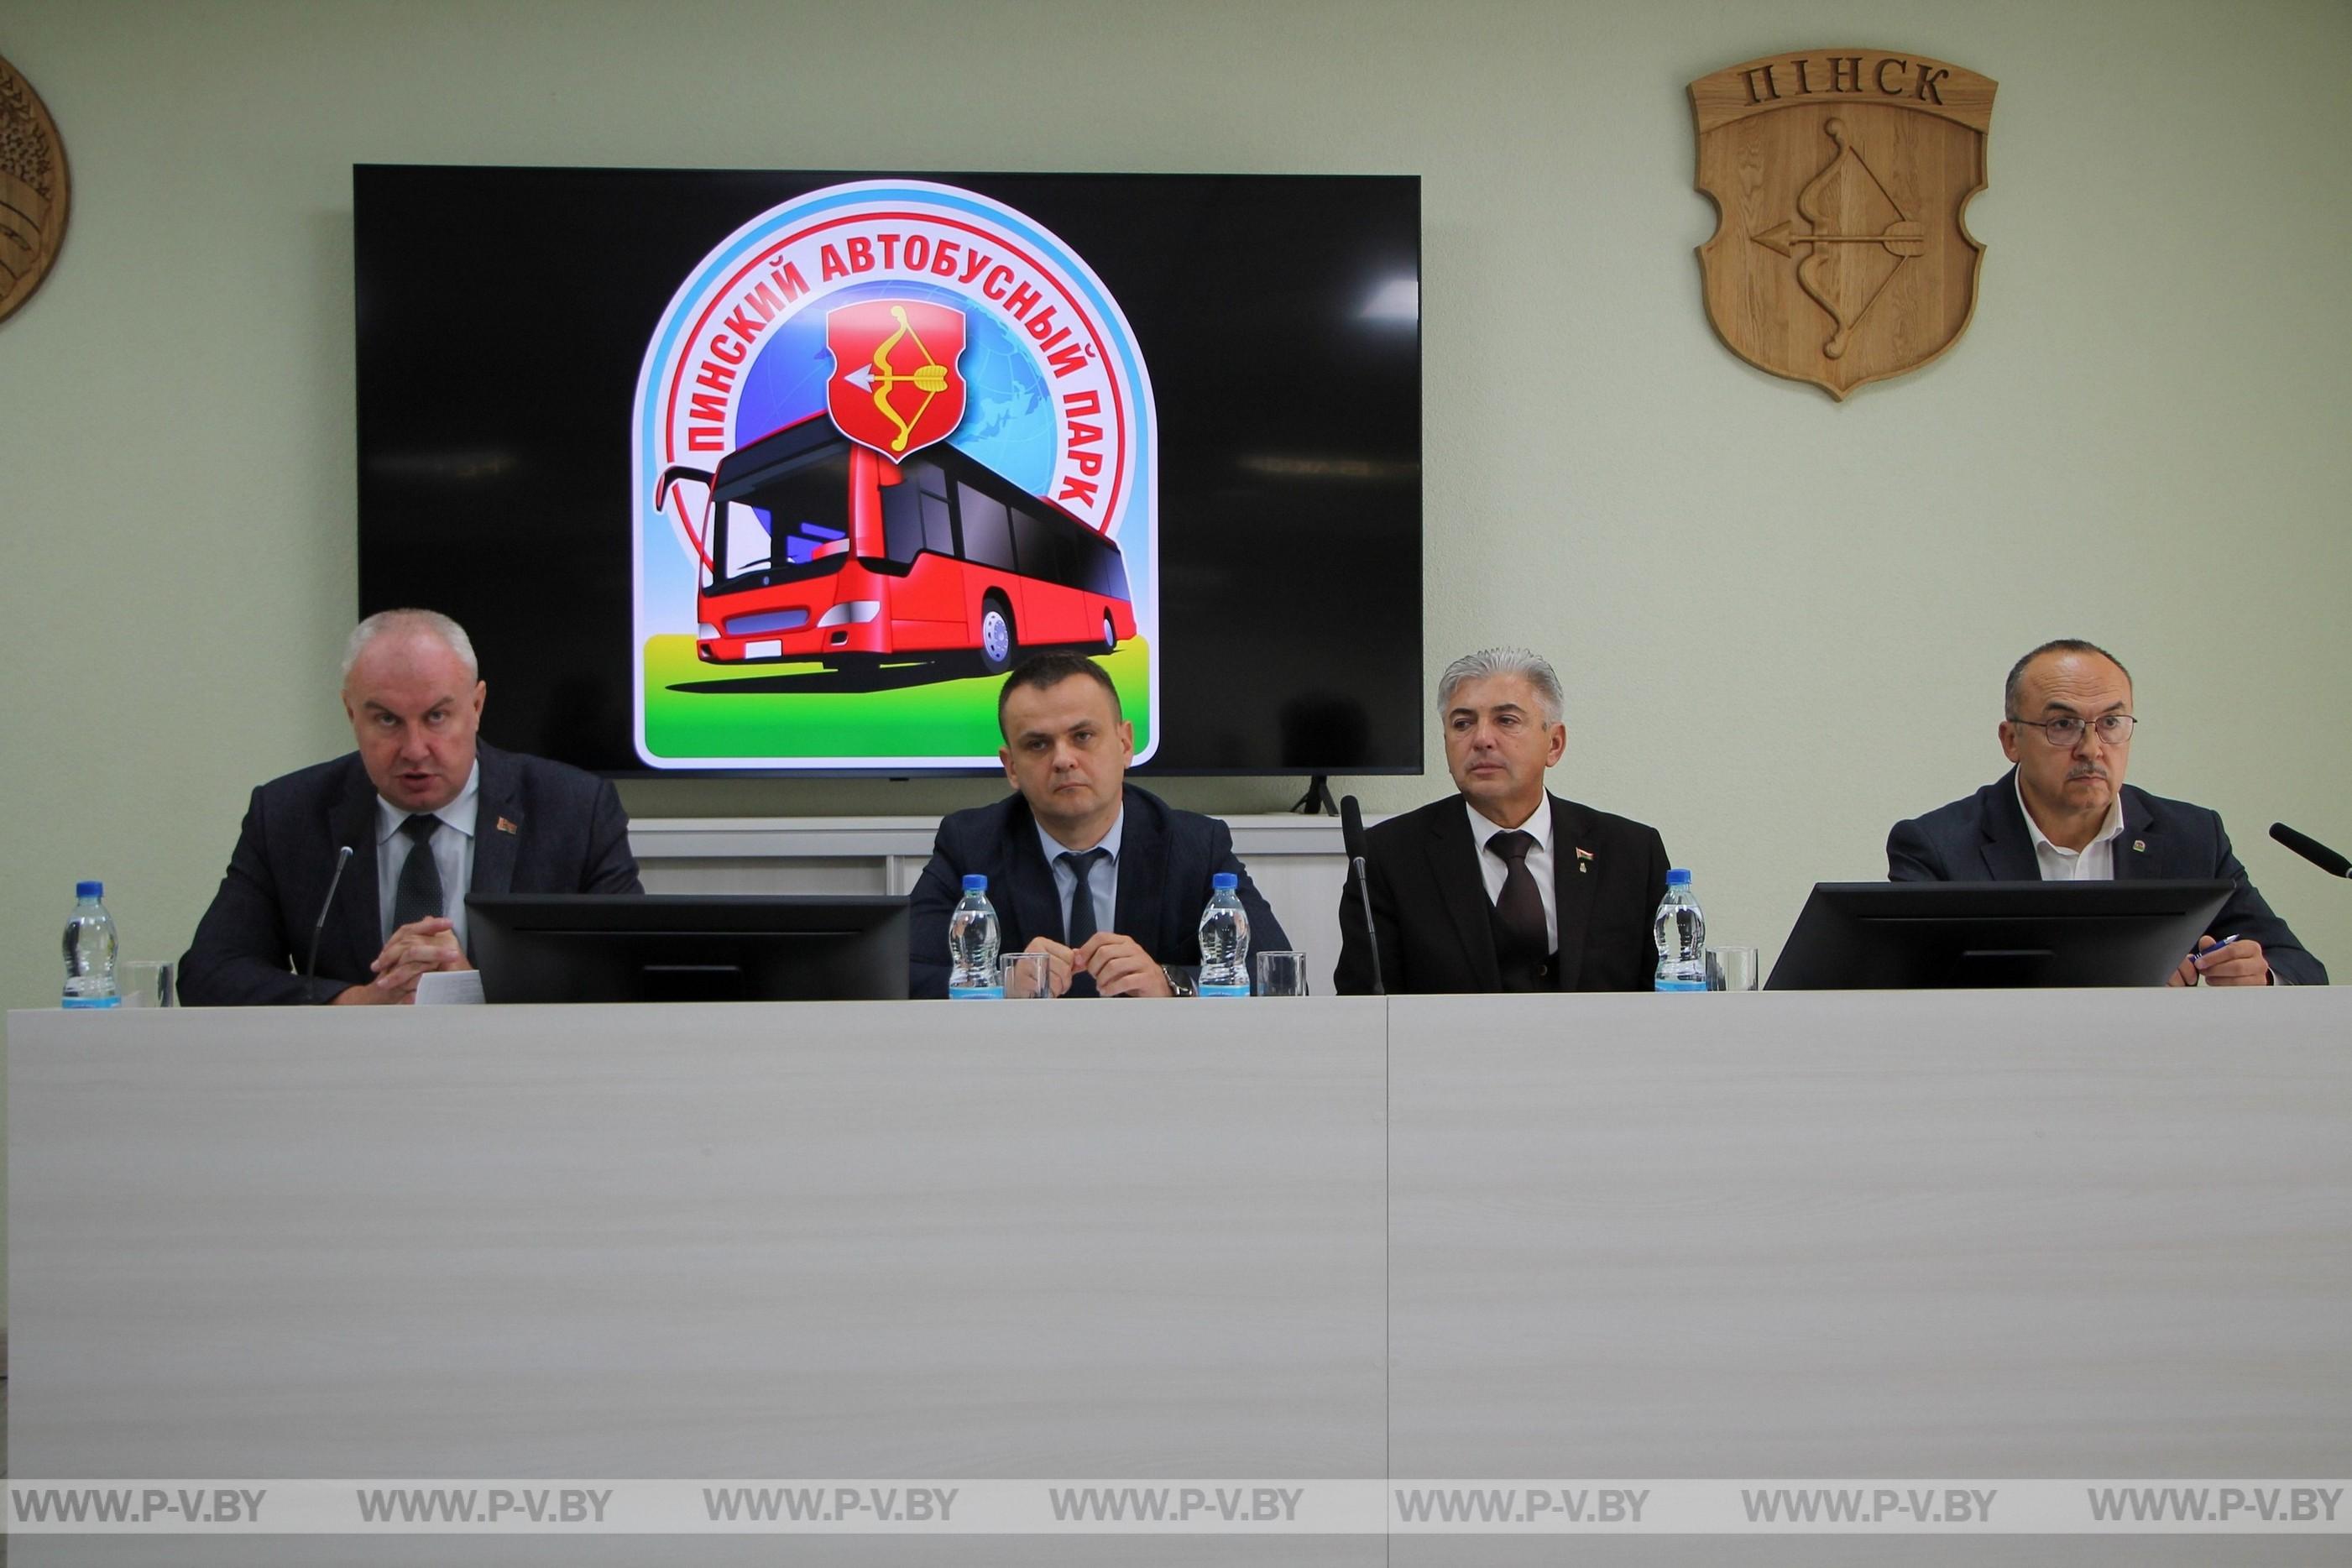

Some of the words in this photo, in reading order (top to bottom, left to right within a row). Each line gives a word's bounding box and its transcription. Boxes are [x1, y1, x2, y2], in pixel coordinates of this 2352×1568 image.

[1738, 57, 1950, 107] ПІНСК
[687, 254, 810, 452] ПИНСКИЙ
[820, 233, 1096, 379] АВТОБУСНЫЙ
[1058, 389, 1104, 509] ПАРК
